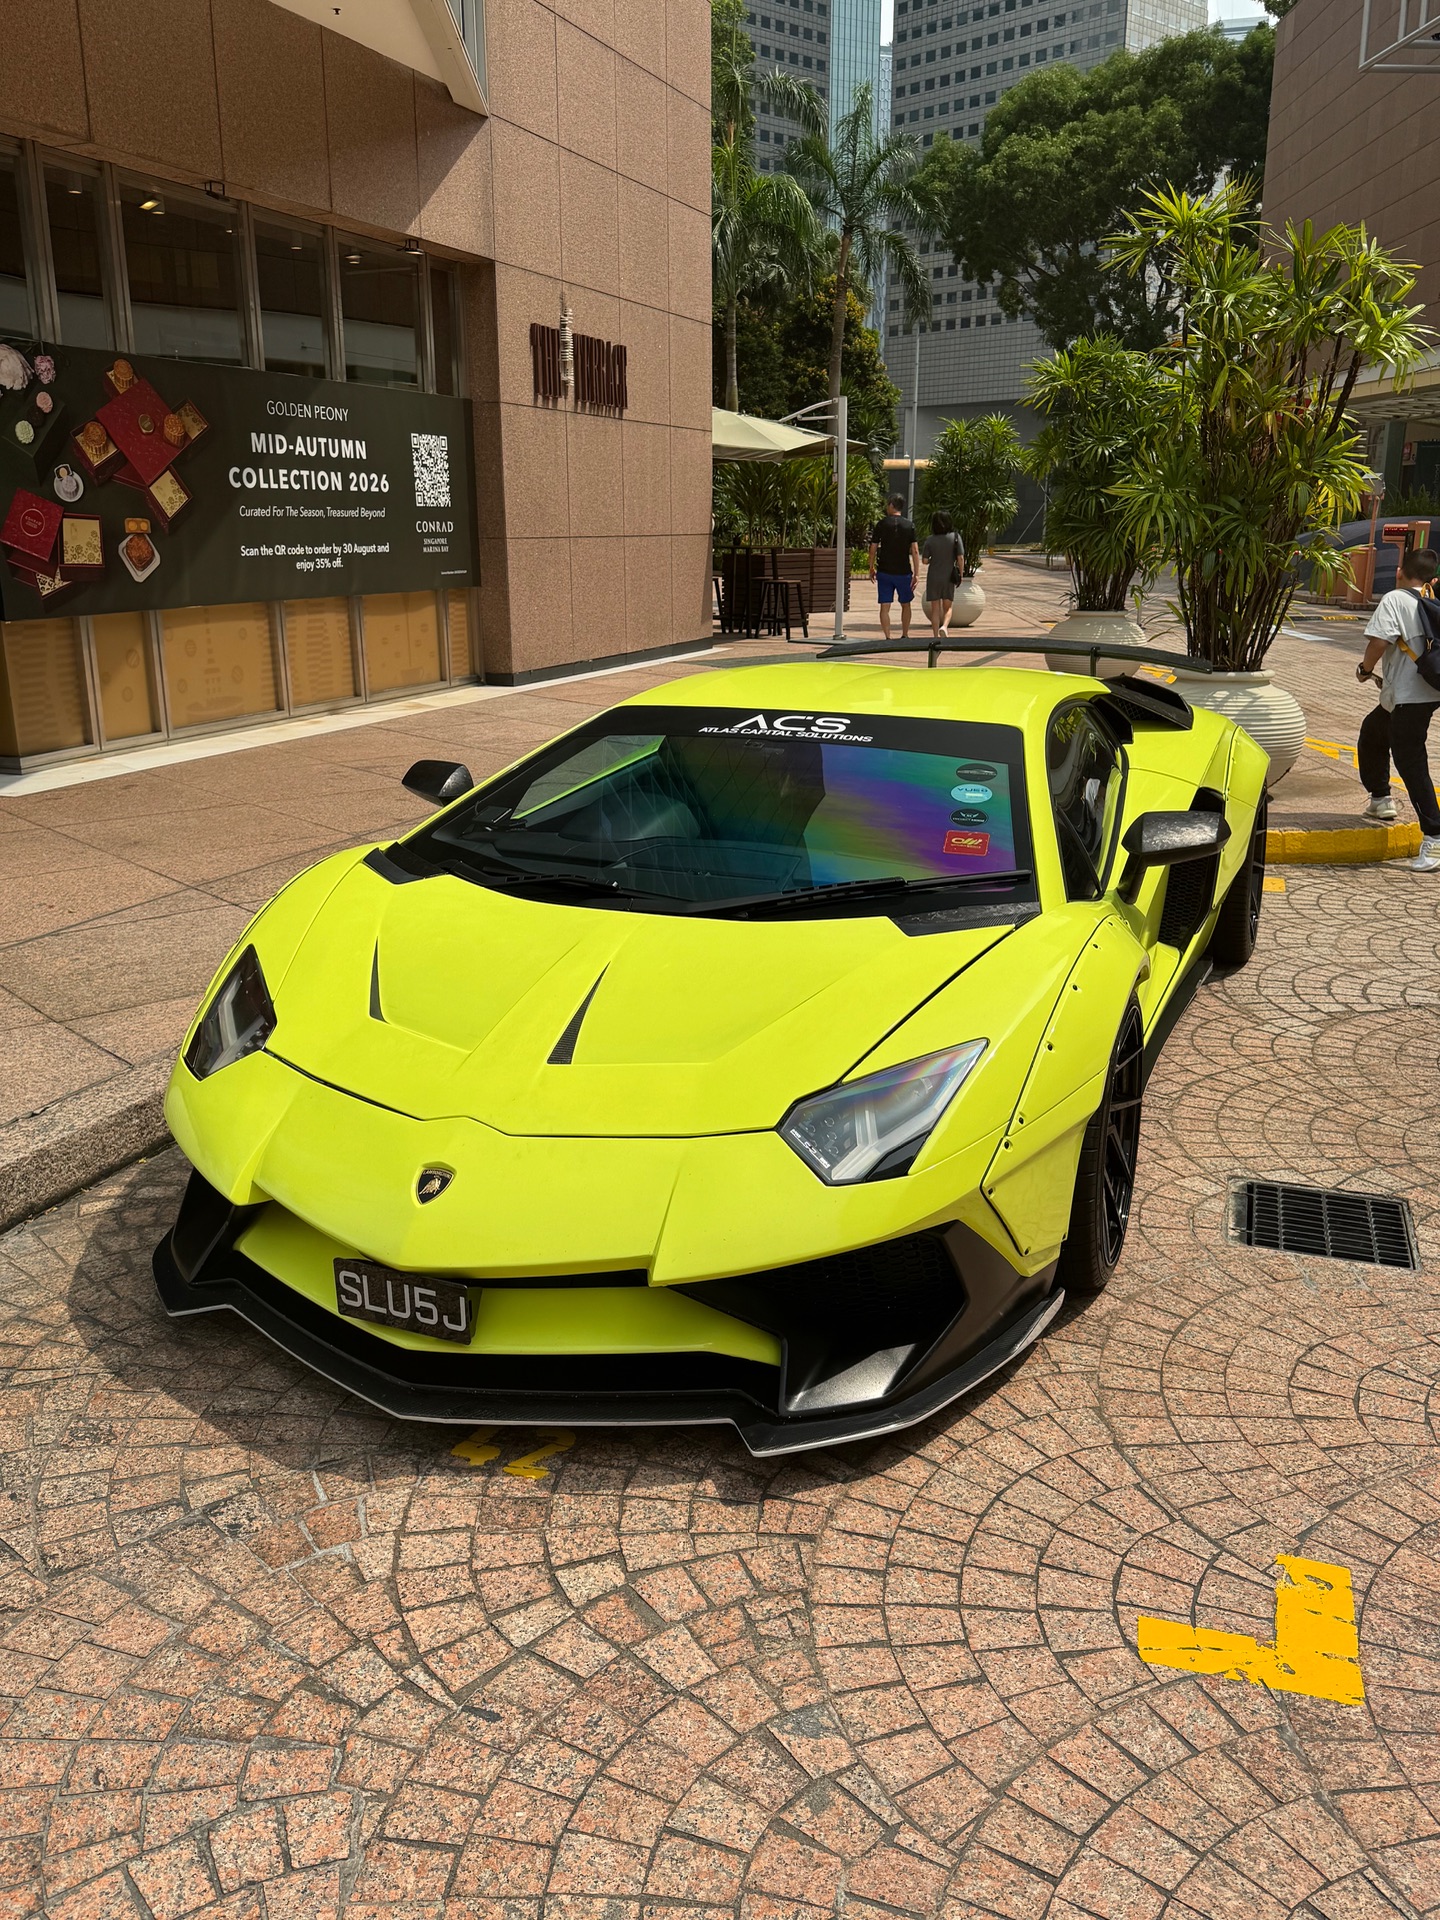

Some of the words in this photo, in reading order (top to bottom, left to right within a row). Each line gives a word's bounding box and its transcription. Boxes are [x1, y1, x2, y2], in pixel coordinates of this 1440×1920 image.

[266, 400, 312, 418] GOLDEN
[314, 405, 349, 421] PEONY
[250, 432, 367, 460] MID-AUTUMN
[228, 466, 343, 491] COLLECTION
[349, 472, 390, 493] 2026
[239, 505, 271, 517] Curated
[272, 506, 284, 517] For
[285, 506, 299, 517] The
[300, 506, 325, 519] Season,
[326, 507, 359, 518] Treasured
[360, 507, 386, 520] Beyond
[415, 520, 454, 533] CONRAD
[240, 545, 259, 556] Scan
[260, 544, 273, 556] the
[274, 544, 286, 555] QR
[287, 544, 304, 555] code
[305, 545, 313, 555] to
[313, 543, 332, 555] order
[332, 543, 342, 556] by
[342, 543, 353, 554] 30
[353, 543, 377, 556] August
[377, 542, 390, 553] and
[296, 559, 315, 572] enjoy
[315, 558, 332, 569] 35%
[332, 557, 344, 568] off.
[732, 713, 852, 734] ACS
[698, 726, 740, 734] ATLAS
[740, 728, 793, 737] CAPITAL
[795, 731, 874, 743] SOLUTIONS
[338, 1270, 468, 1333] SLU5J
